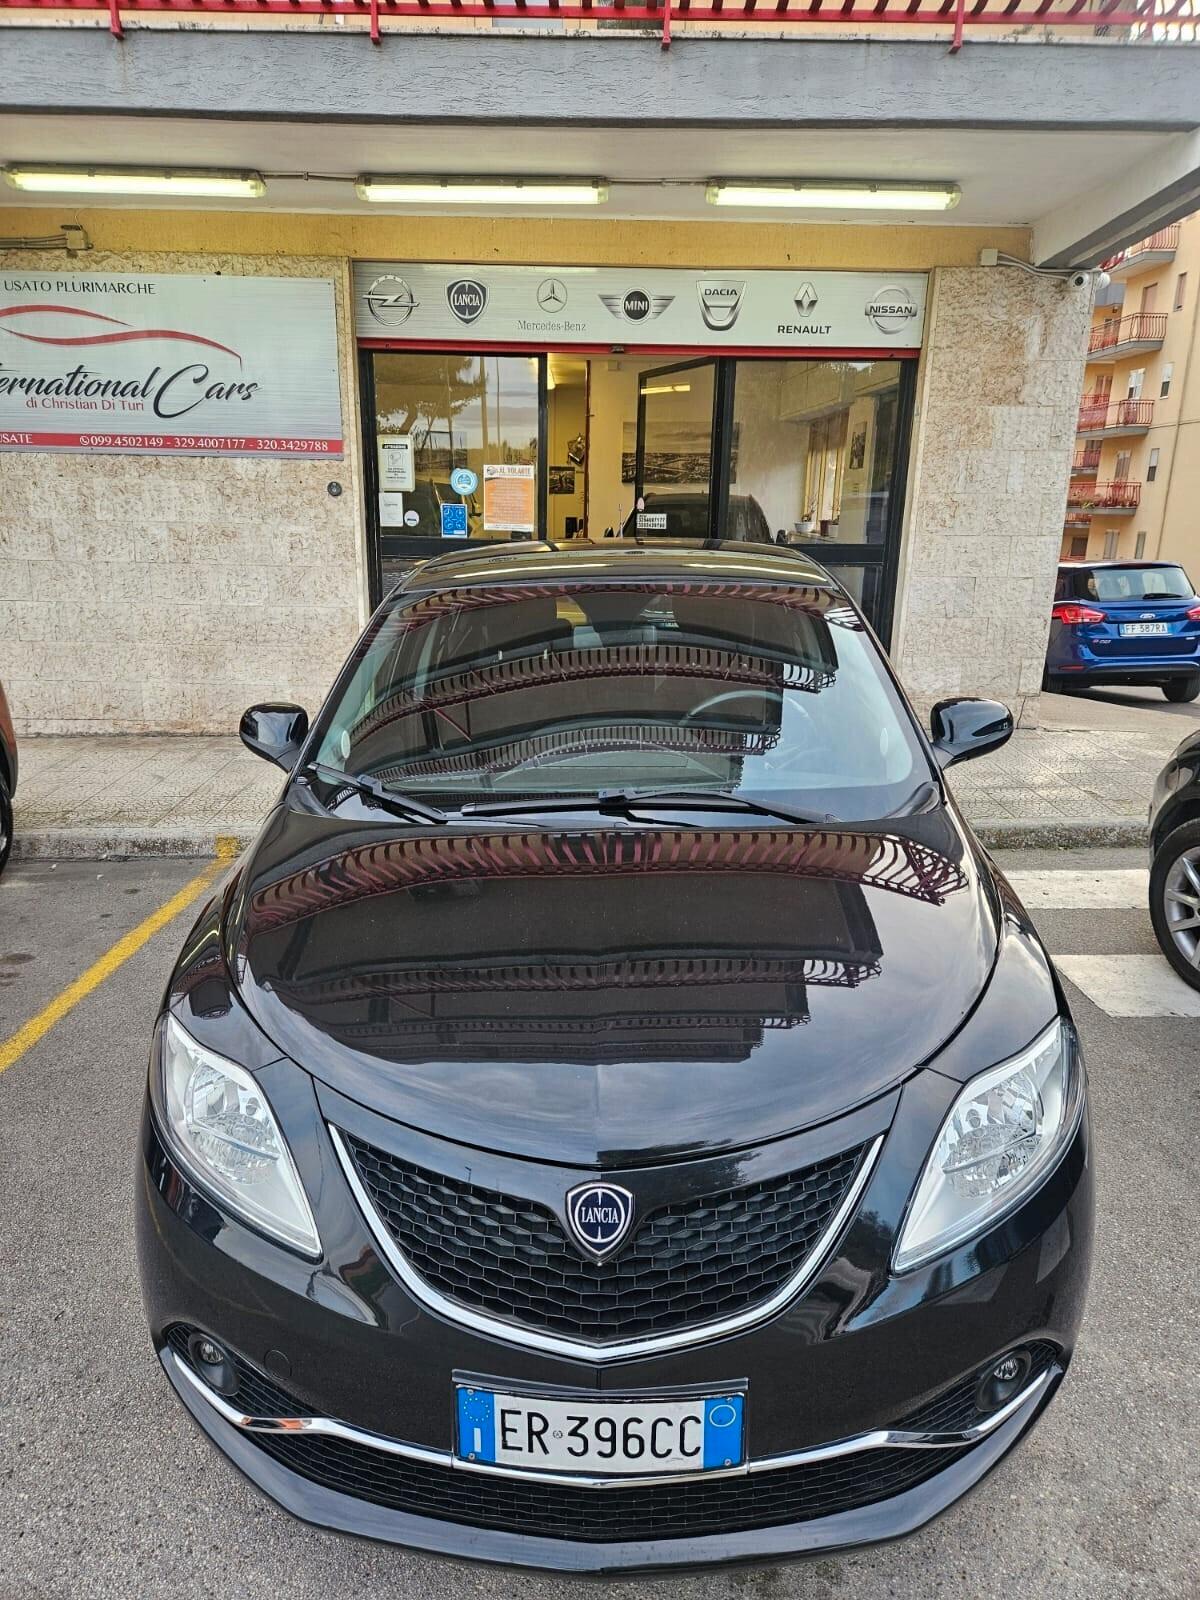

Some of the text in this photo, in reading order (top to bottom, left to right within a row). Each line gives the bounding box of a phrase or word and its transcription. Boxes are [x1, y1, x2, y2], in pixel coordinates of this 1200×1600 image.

[4, 280, 157, 295] USATO PLURIMARCHE
[704, 288, 738, 297] DACIA
[453, 294, 481, 307] LANCIA
[624, 300, 648, 311] MINI
[869, 305, 913, 315] NISSAN
[517, 320, 586, 332] Mercedes-Benz
[777, 324, 832, 335] RENAULT
[0, 363, 262, 419] ernational Cars
[26, 397, 144, 412] di Christian Di Turi
[91, 436, 163, 448] 099.4502149
[175, 437, 245, 449] 329.4007177
[257, 439, 328, 451] 320.3429788
[581, 1207, 619, 1223] LANCIA
[500, 1408, 702, 1459] ER 396CC
